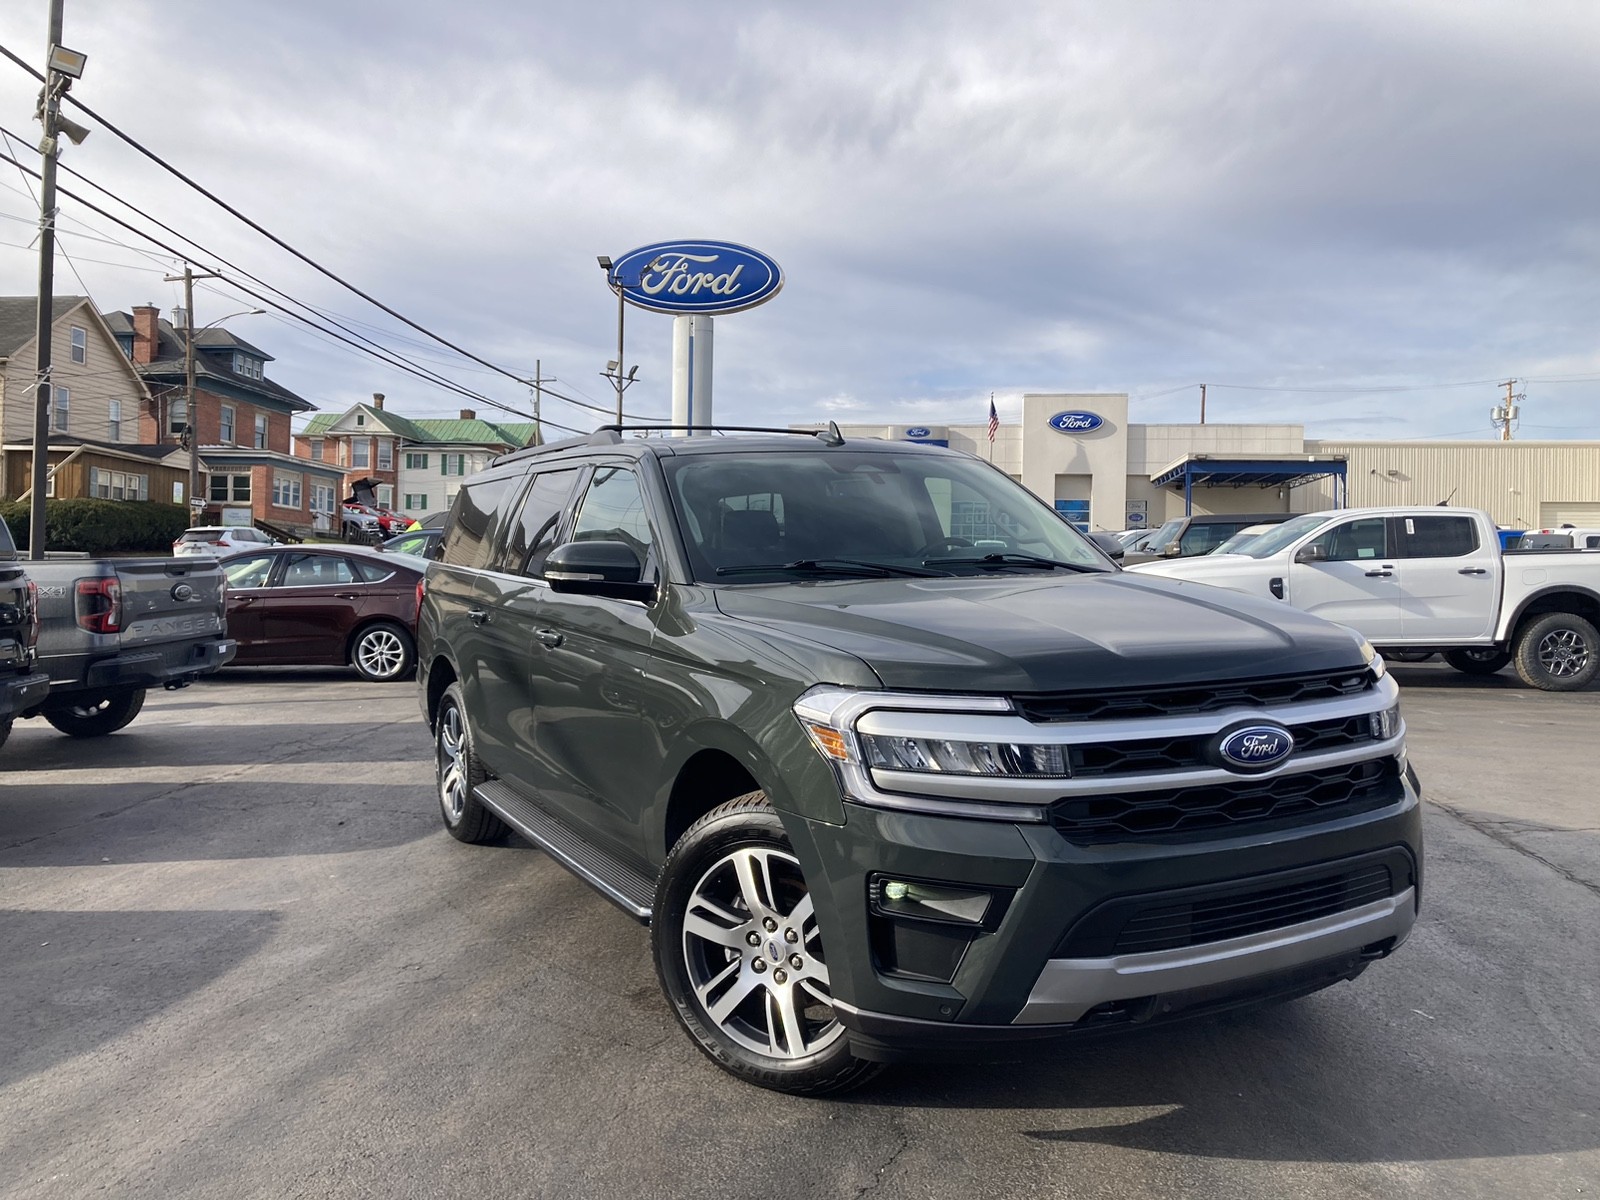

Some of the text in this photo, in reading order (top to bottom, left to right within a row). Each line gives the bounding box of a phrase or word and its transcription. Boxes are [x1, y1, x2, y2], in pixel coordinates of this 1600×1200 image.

[641, 252, 746, 295] Ford
[1059, 415, 1092, 428] Ford
[132, 614, 219, 635] RANGER
[1241, 735, 1279, 758] Ford
